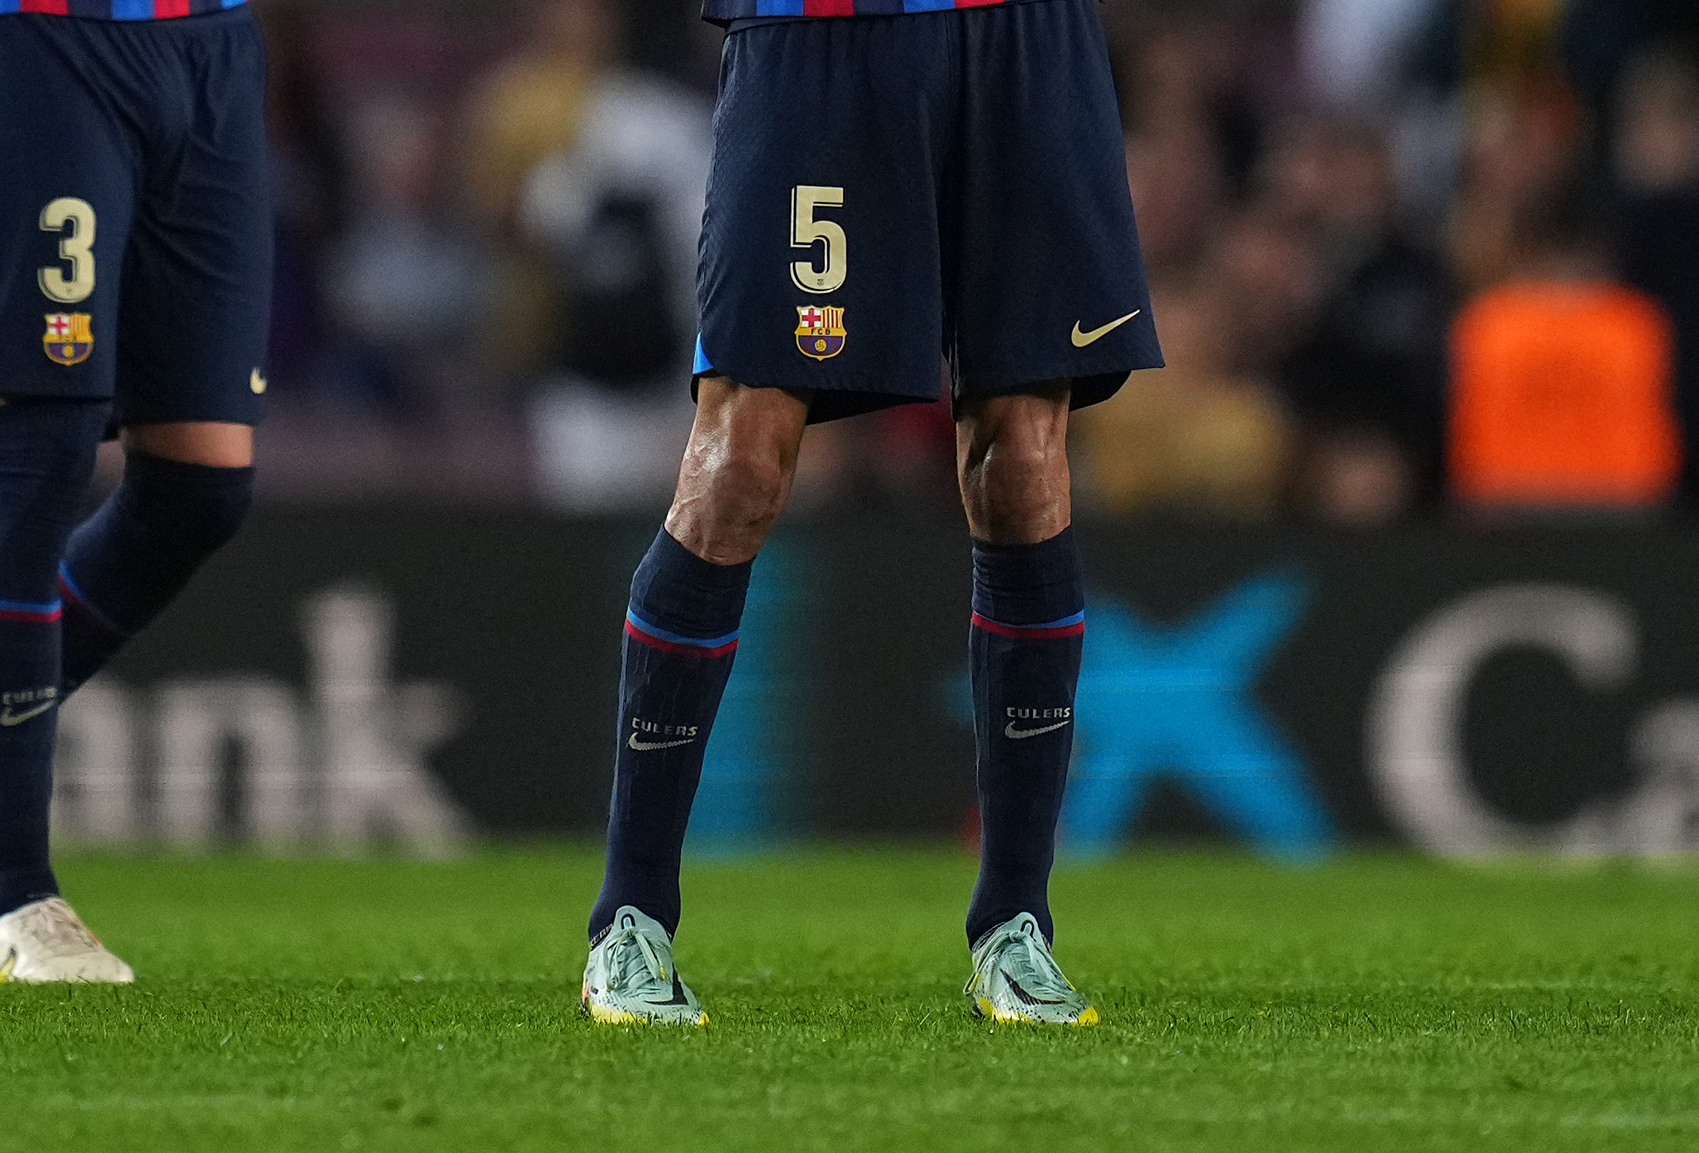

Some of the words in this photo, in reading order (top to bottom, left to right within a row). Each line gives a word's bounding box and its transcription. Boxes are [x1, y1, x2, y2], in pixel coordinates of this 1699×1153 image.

[37, 197, 96, 303] 3
[789, 184, 848, 295] 5
[810, 328, 832, 336] FCB
